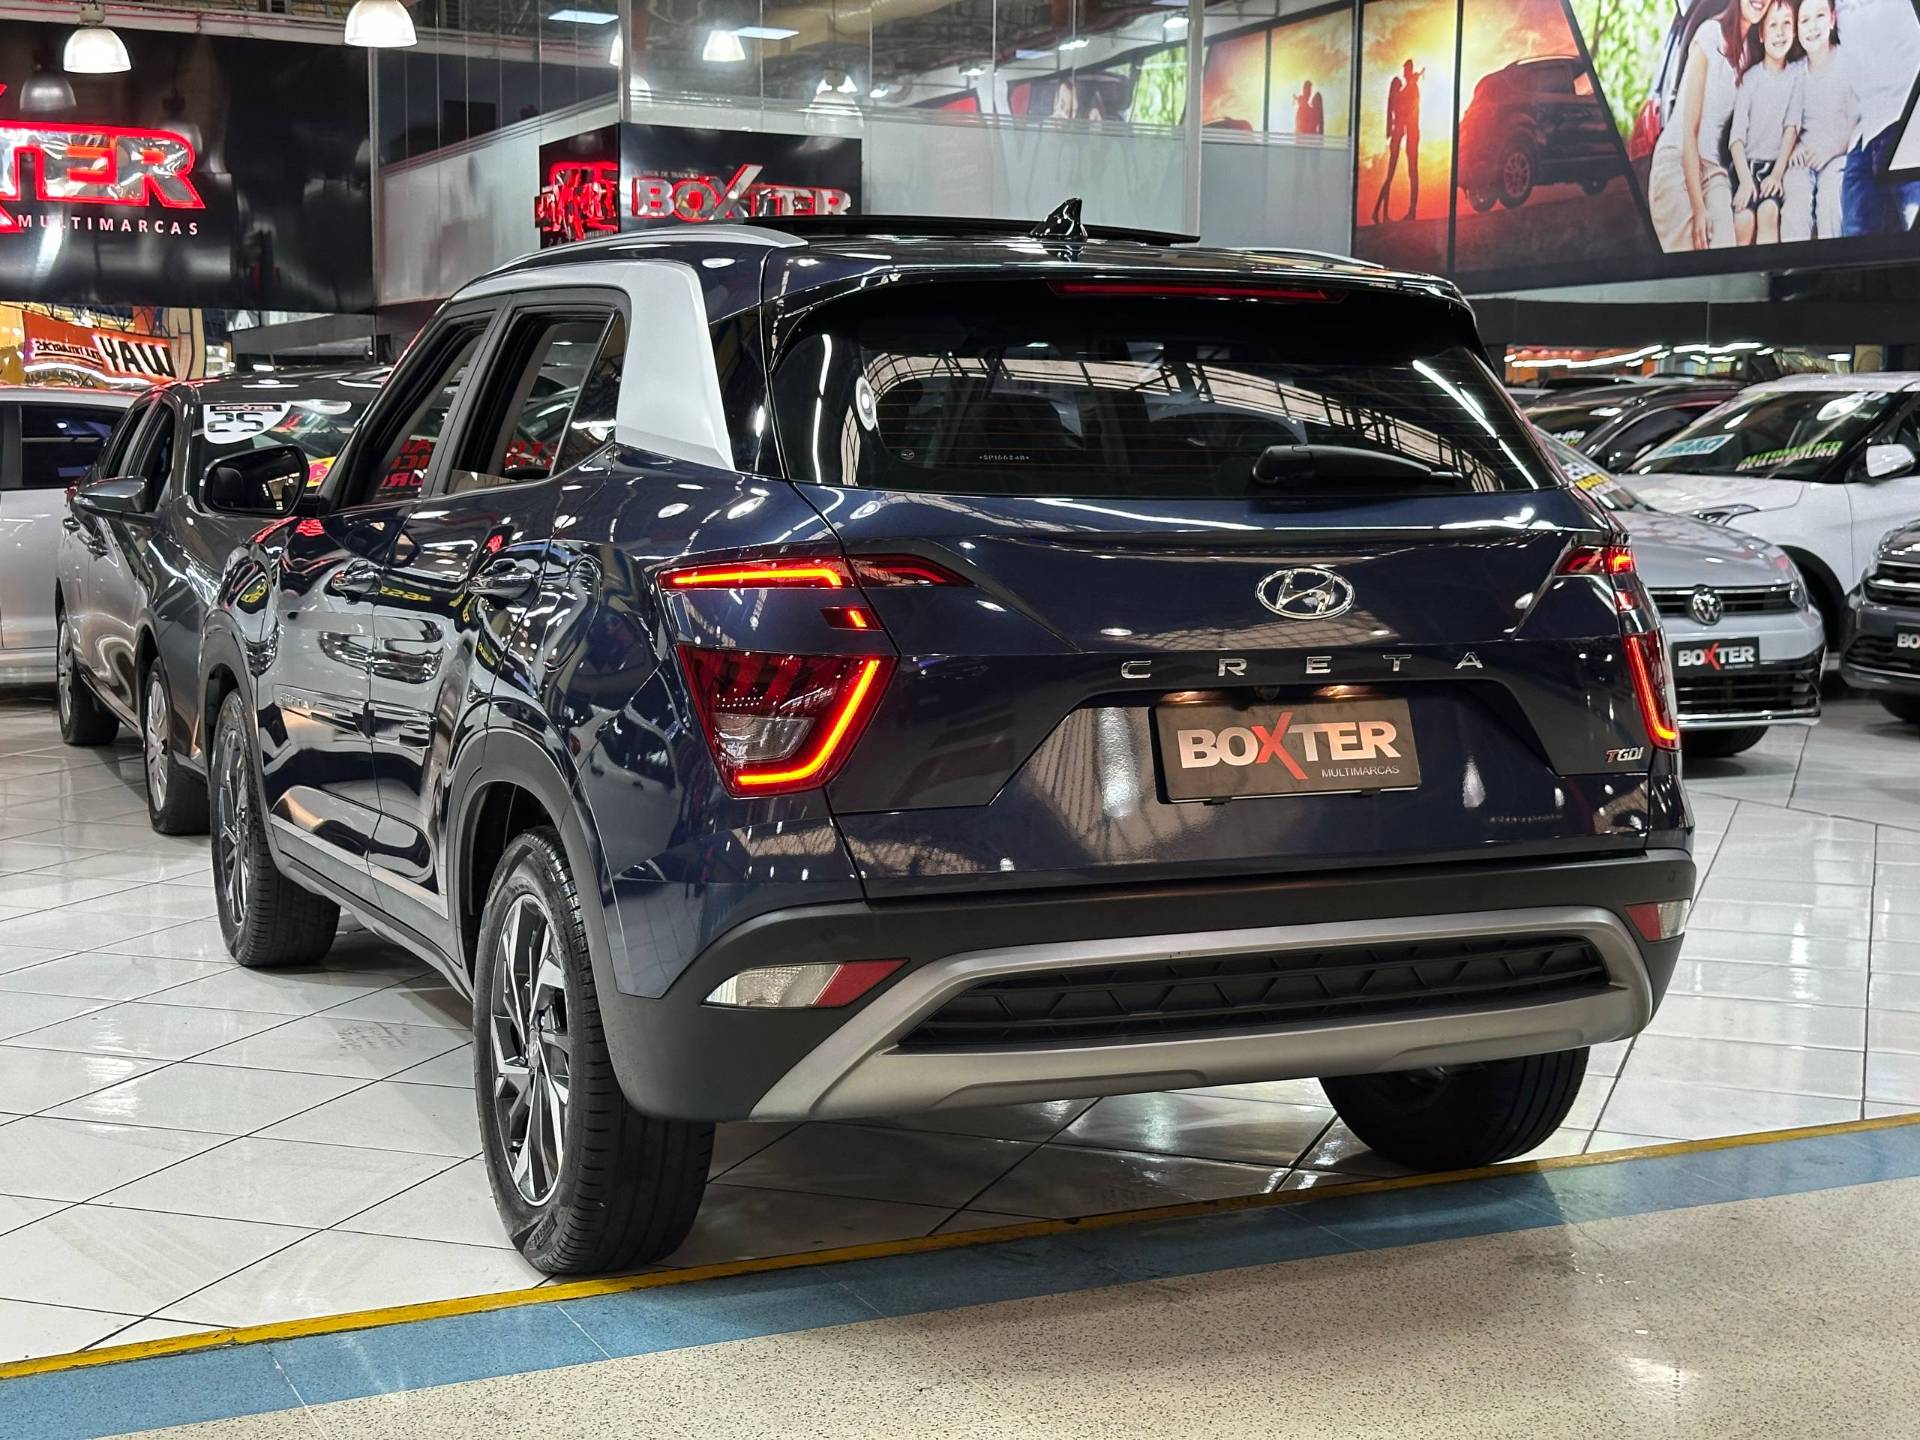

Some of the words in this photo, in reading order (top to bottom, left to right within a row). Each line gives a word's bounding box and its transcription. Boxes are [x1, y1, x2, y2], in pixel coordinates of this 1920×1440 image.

[0, 84, 206, 232] TER
[631, 164, 852, 222] BOXTER
[17, 214, 199, 236] MULTIMARCAS
[207, 412, 264, 432] 25
[1120, 651, 1484, 680] CRETA
[1678, 642, 1755, 671] BOXTER
[1177, 711, 1402, 781] BOXTER
[1606, 747, 1644, 762] TGDI
[1321, 765, 1400, 778] MULTIMARCAS
